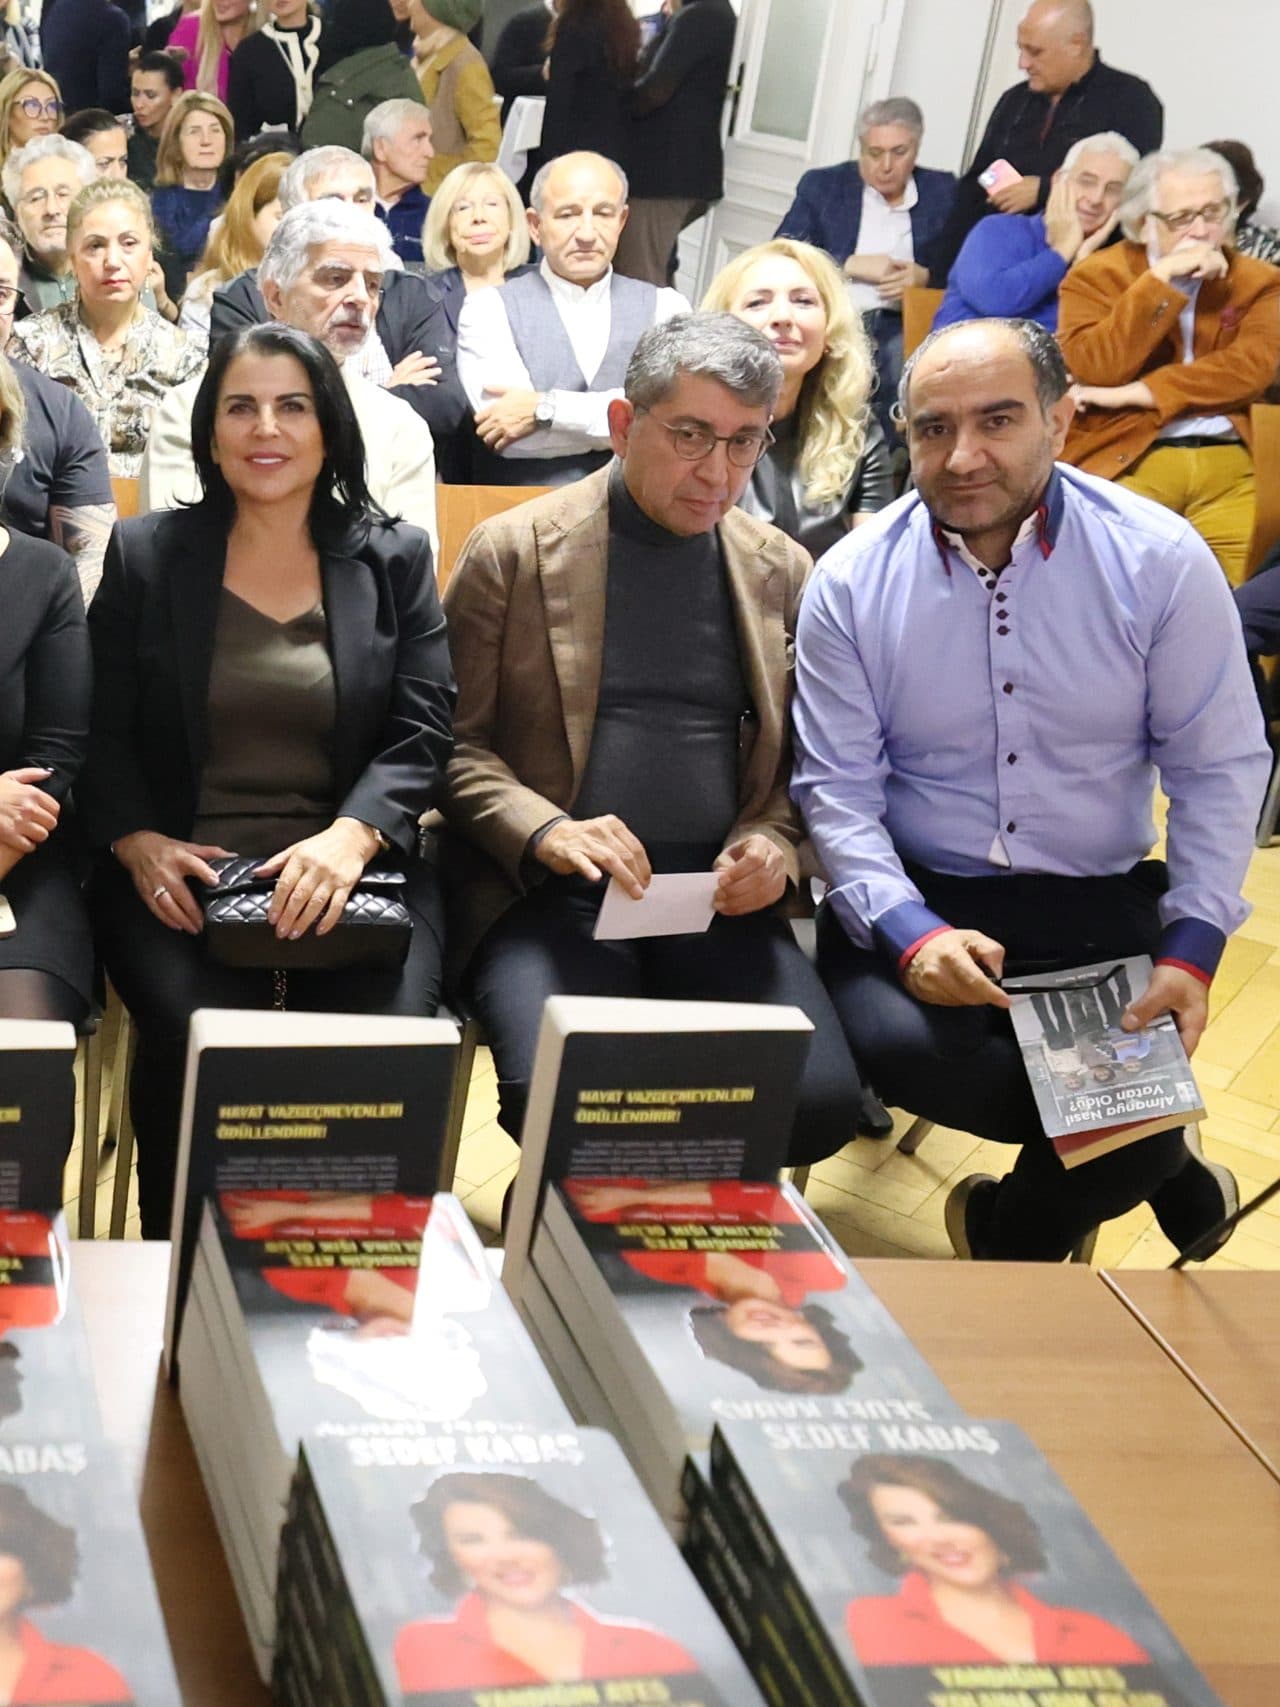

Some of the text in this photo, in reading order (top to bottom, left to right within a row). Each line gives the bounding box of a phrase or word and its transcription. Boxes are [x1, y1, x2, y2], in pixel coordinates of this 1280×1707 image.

[1069, 1093, 1113, 1113] Oldu?
[1116, 1084, 1165, 1101] Vatan
[1107, 1095, 1175, 1117] Almanya
[761, 1421, 1000, 1455] SEDEF KABAŞ
[347, 1433, 585, 1467] SEDEF KABAŞ
